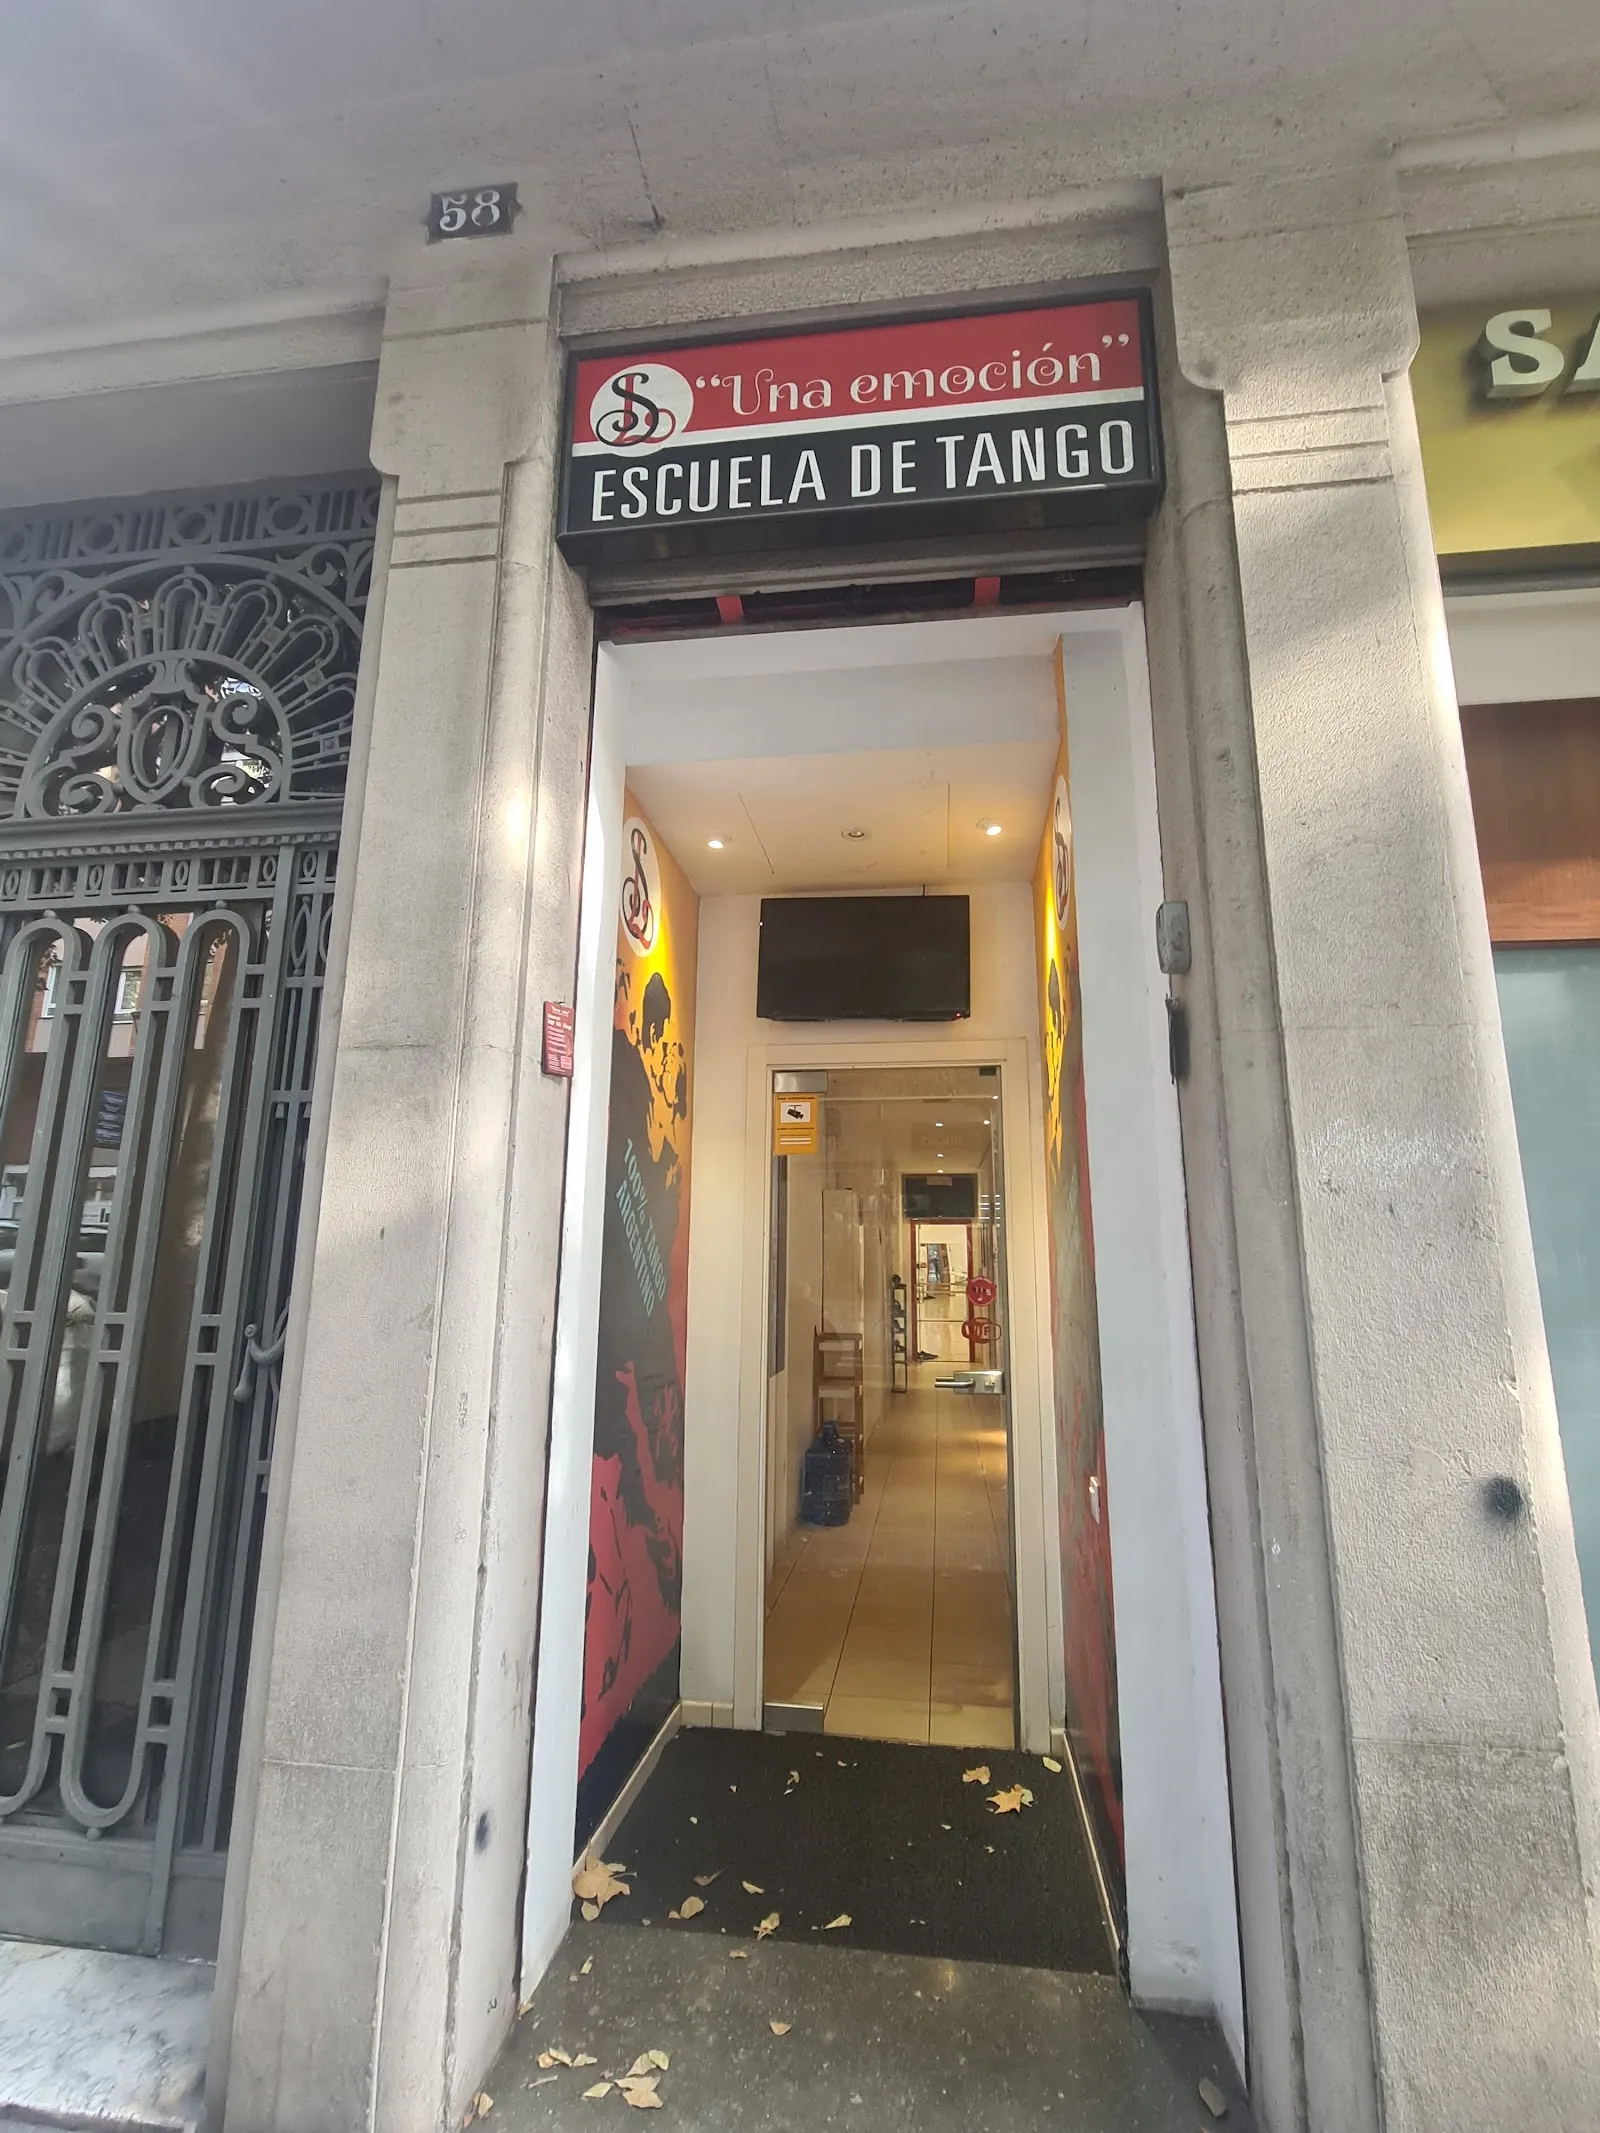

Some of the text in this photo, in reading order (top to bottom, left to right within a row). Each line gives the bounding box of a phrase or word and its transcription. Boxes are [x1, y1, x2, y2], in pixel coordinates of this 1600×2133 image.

[439, 190, 500, 232] 58
[592, 419, 1135, 522] ESCUELA DE TANGO
[615, 1179, 655, 1317] ARGENTINO
[624, 1138, 667, 1302] 100% TANGO
